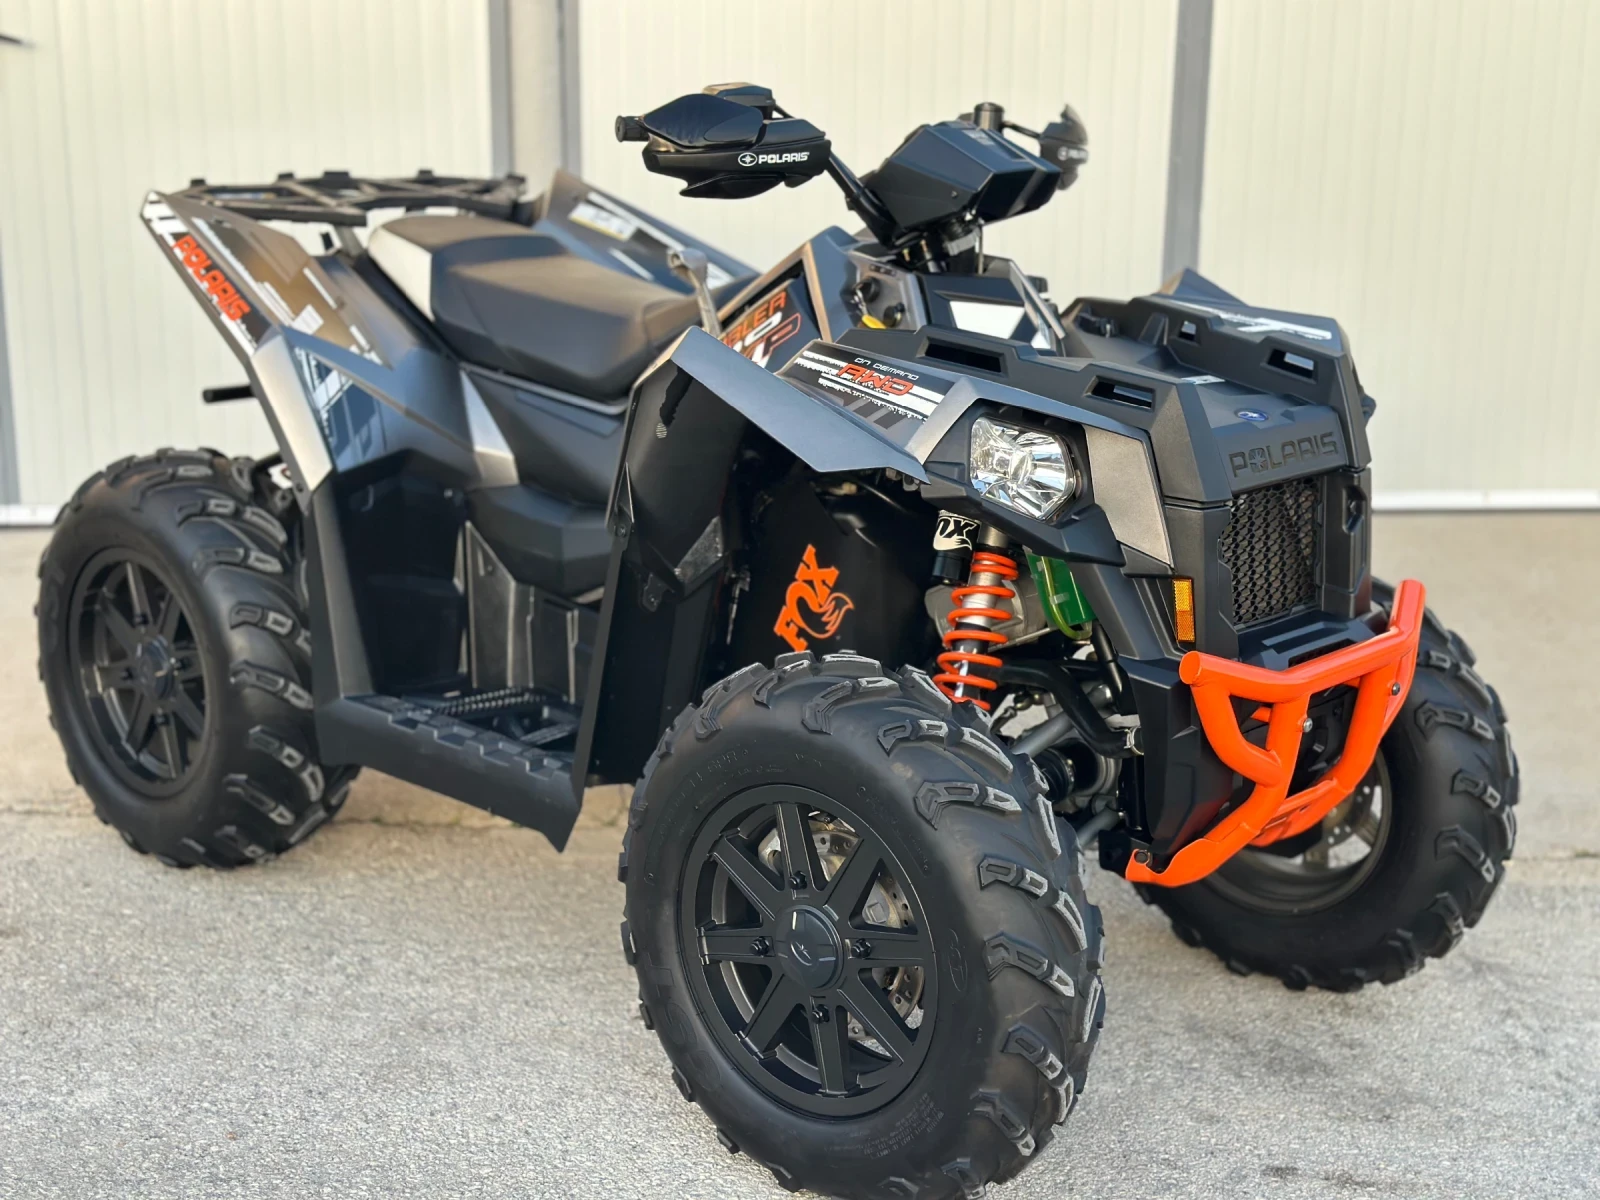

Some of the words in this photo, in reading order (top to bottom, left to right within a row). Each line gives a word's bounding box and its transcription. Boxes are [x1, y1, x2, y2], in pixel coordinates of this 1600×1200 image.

[758, 152, 810, 164] POLARIS
[172, 234, 251, 322] POLARIS
[722, 291, 787, 348] BLER
[837, 363, 915, 396] AWD
[873, 362, 920, 381] DEMAND
[1229, 432, 1339, 478] POLARIS
[936, 516, 978, 539] OX
[773, 544, 853, 652] FOX
